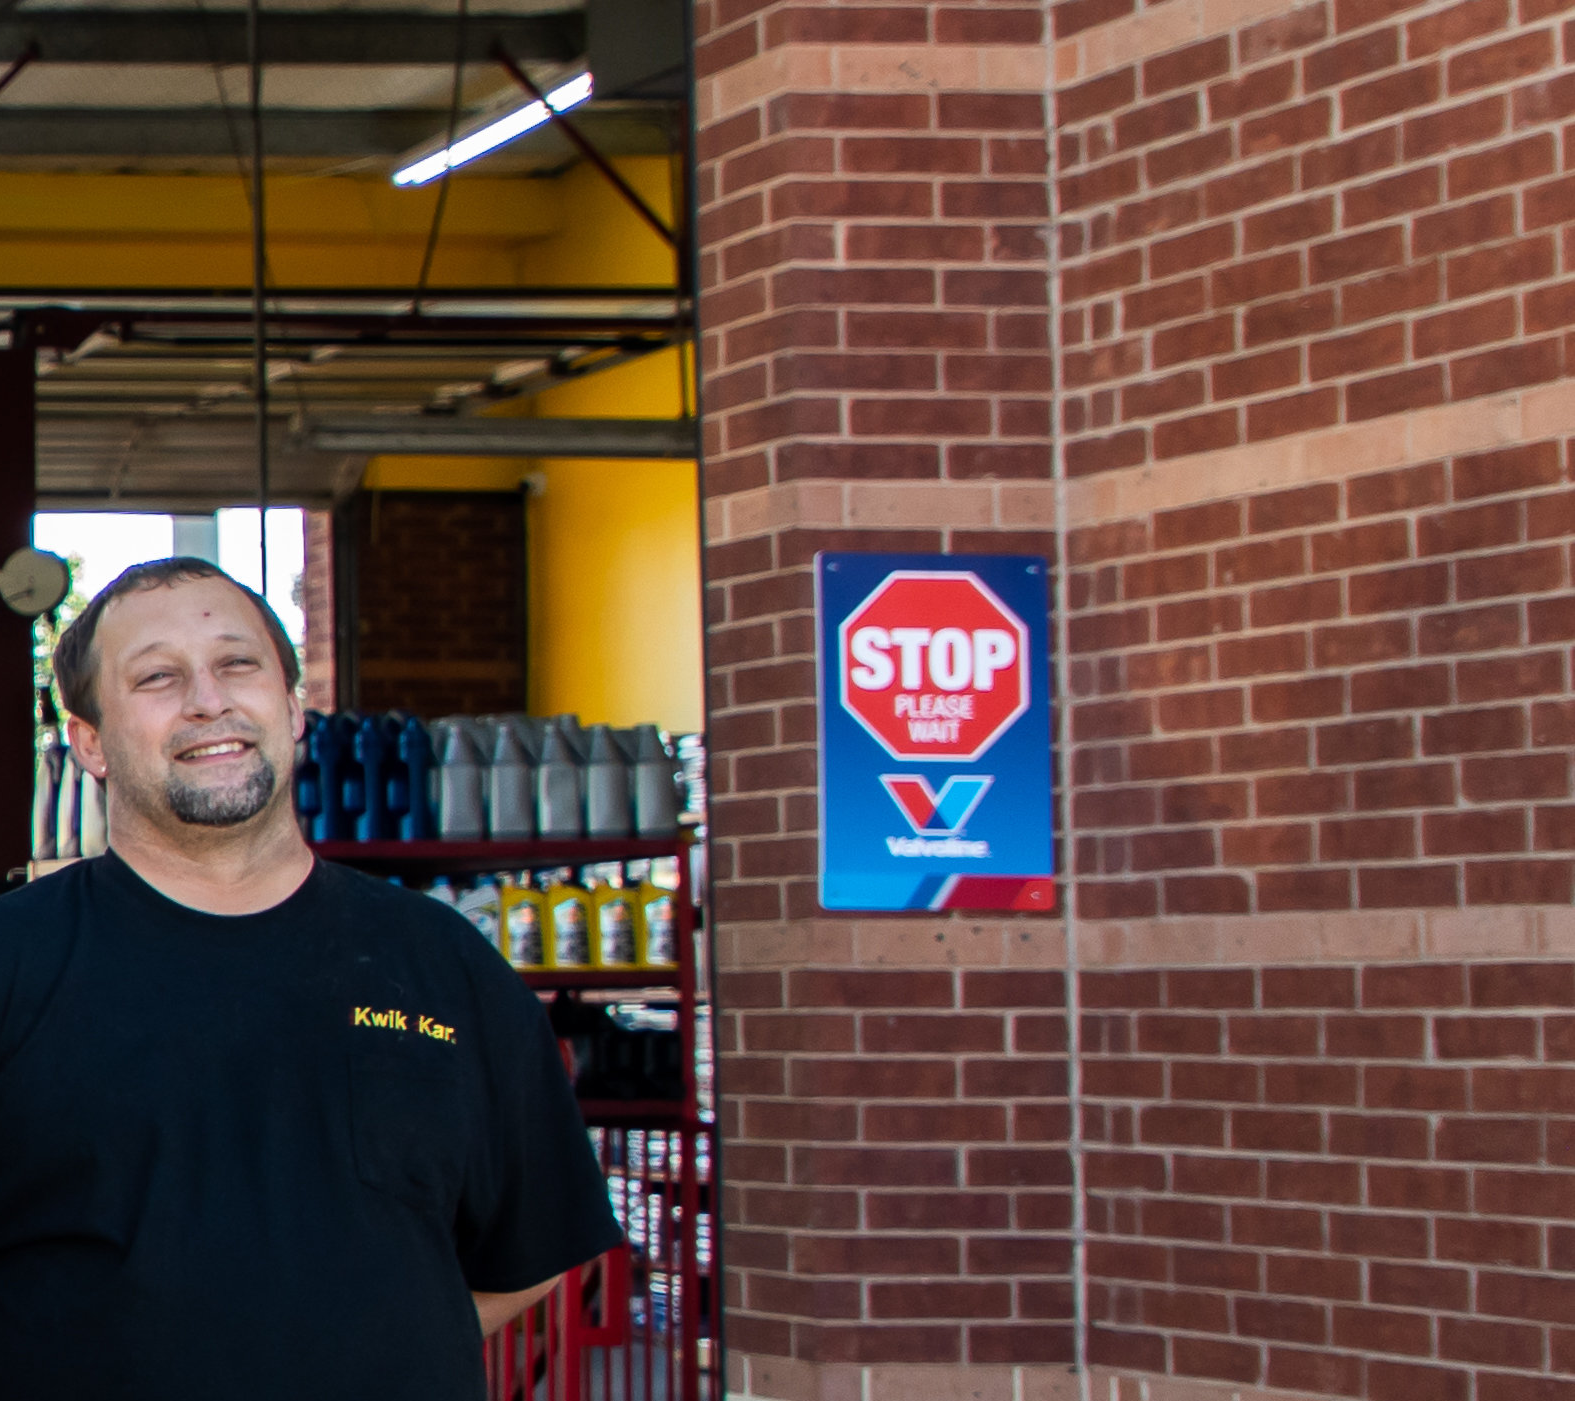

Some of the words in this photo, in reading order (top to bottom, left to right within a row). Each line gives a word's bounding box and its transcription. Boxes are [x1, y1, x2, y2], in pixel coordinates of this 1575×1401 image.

[850, 625, 1017, 692] STOP
[894, 694, 975, 720] PLEASE
[907, 719, 962, 744] WAIT
[885, 836, 989, 858] Valvoline
[349, 1006, 408, 1031] Kwik
